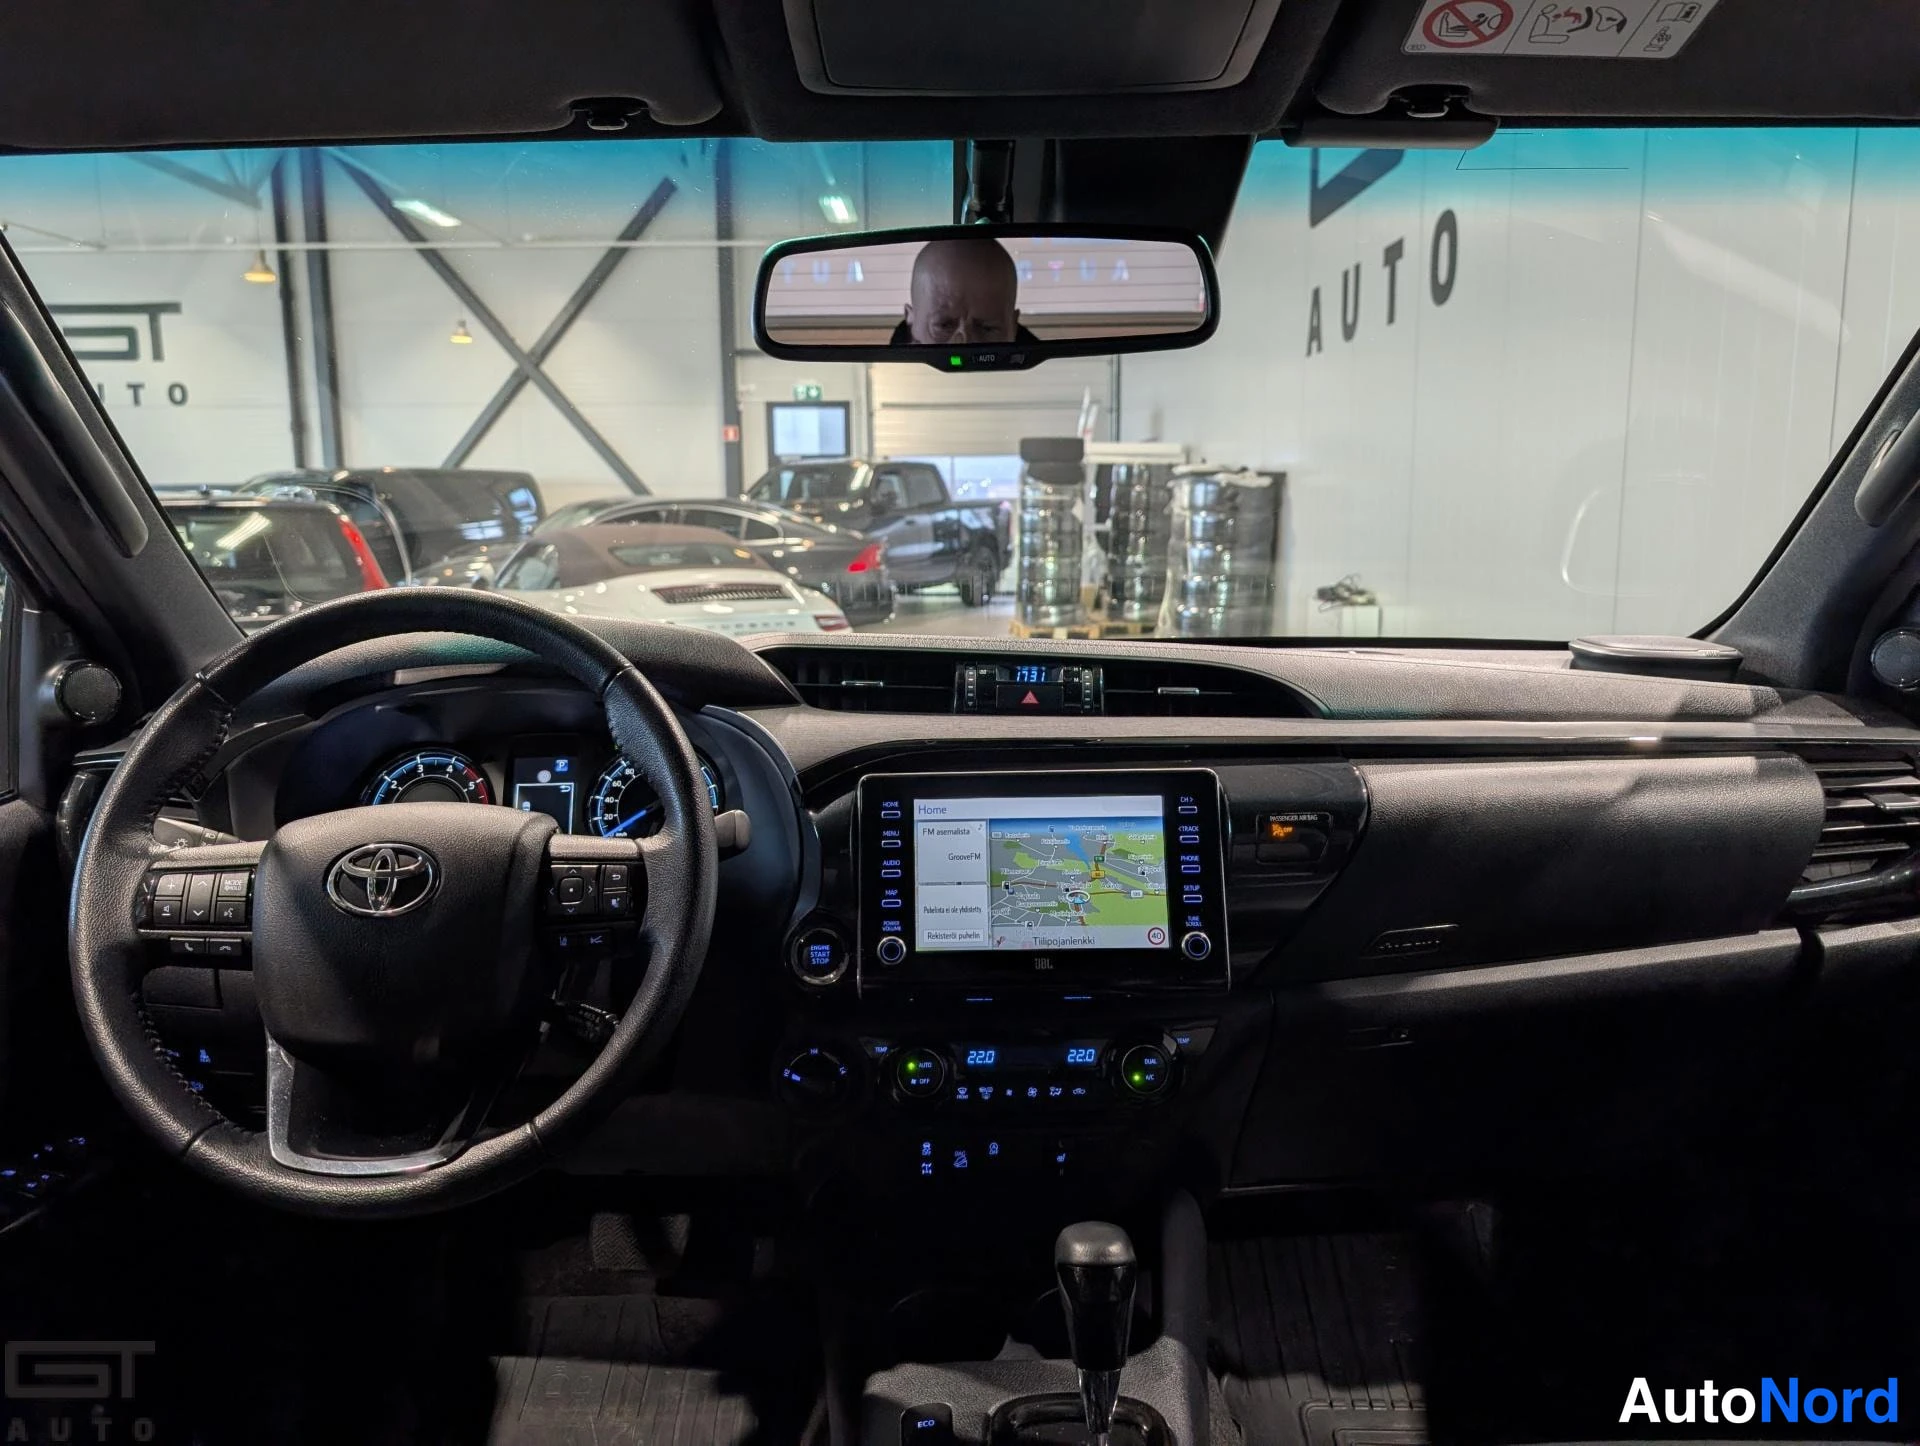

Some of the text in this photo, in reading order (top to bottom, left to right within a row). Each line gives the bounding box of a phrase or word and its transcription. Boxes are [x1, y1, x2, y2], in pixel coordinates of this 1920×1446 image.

[1306, 208, 1458, 358] AUTO
[978, 354, 996, 362] AUTO
[417, 763, 426, 773] 3
[445, 763, 454, 773] 4
[390, 780, 400, 789] 2
[468, 781, 477, 790] 5
[612, 779, 622, 787] 60
[604, 796, 615, 804] 40
[918, 804, 947, 815] Home
[922, 827, 970, 836] FM asemalista
[958, 930, 980, 942] puhelin
[1150, 932, 1162, 941] 40
[1177, 1037, 1191, 1045] TEMP
[967, 1050, 996, 1064] 22.0
[1067, 1048, 1096, 1063] 22.0
[918, 1061, 932, 1069] AUTO
[1145, 1073, 1155, 1081] A/C
[917, 1419, 935, 1429] ECO
